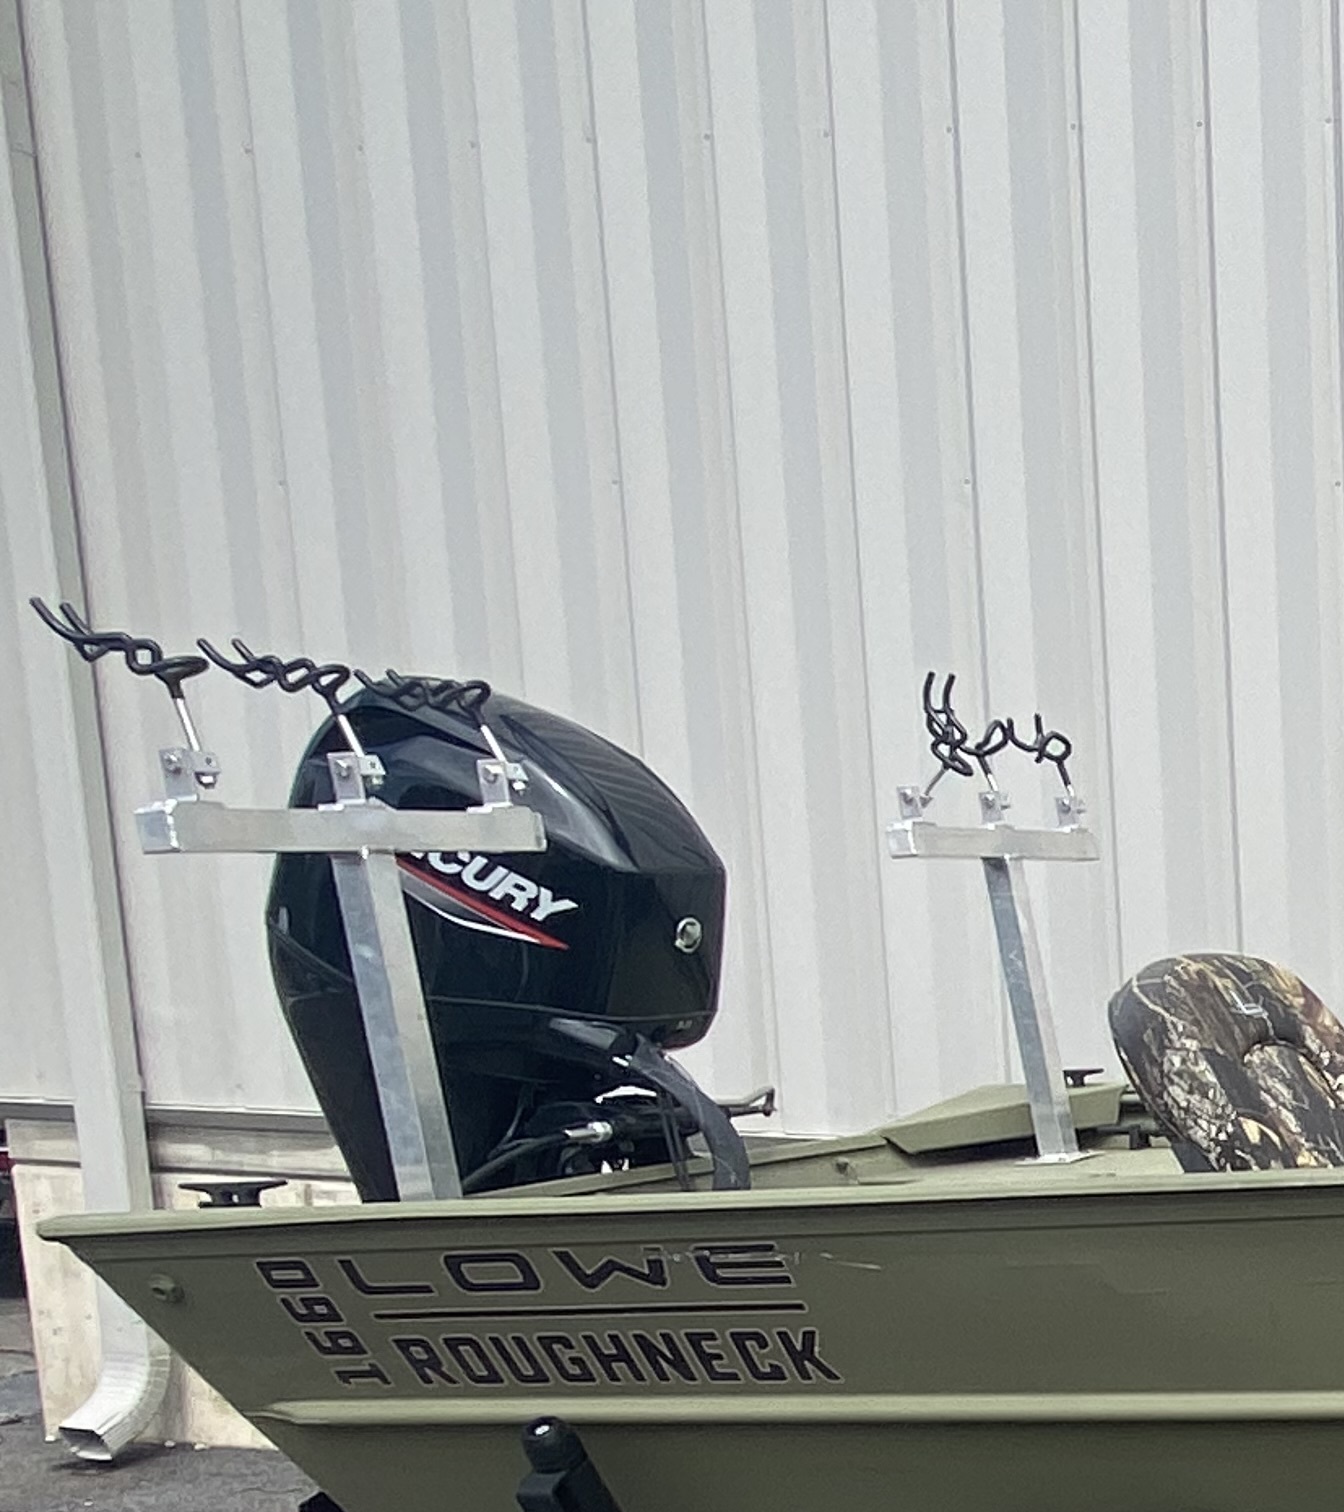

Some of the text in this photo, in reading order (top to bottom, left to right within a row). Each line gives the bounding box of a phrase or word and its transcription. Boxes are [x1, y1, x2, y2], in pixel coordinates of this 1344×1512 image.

[409, 851, 579, 922] CURY
[335, 1242, 794, 1296] LOWE
[254, 1259, 393, 1387] 1660
[391, 1329, 843, 1386] ROUGHNECK
